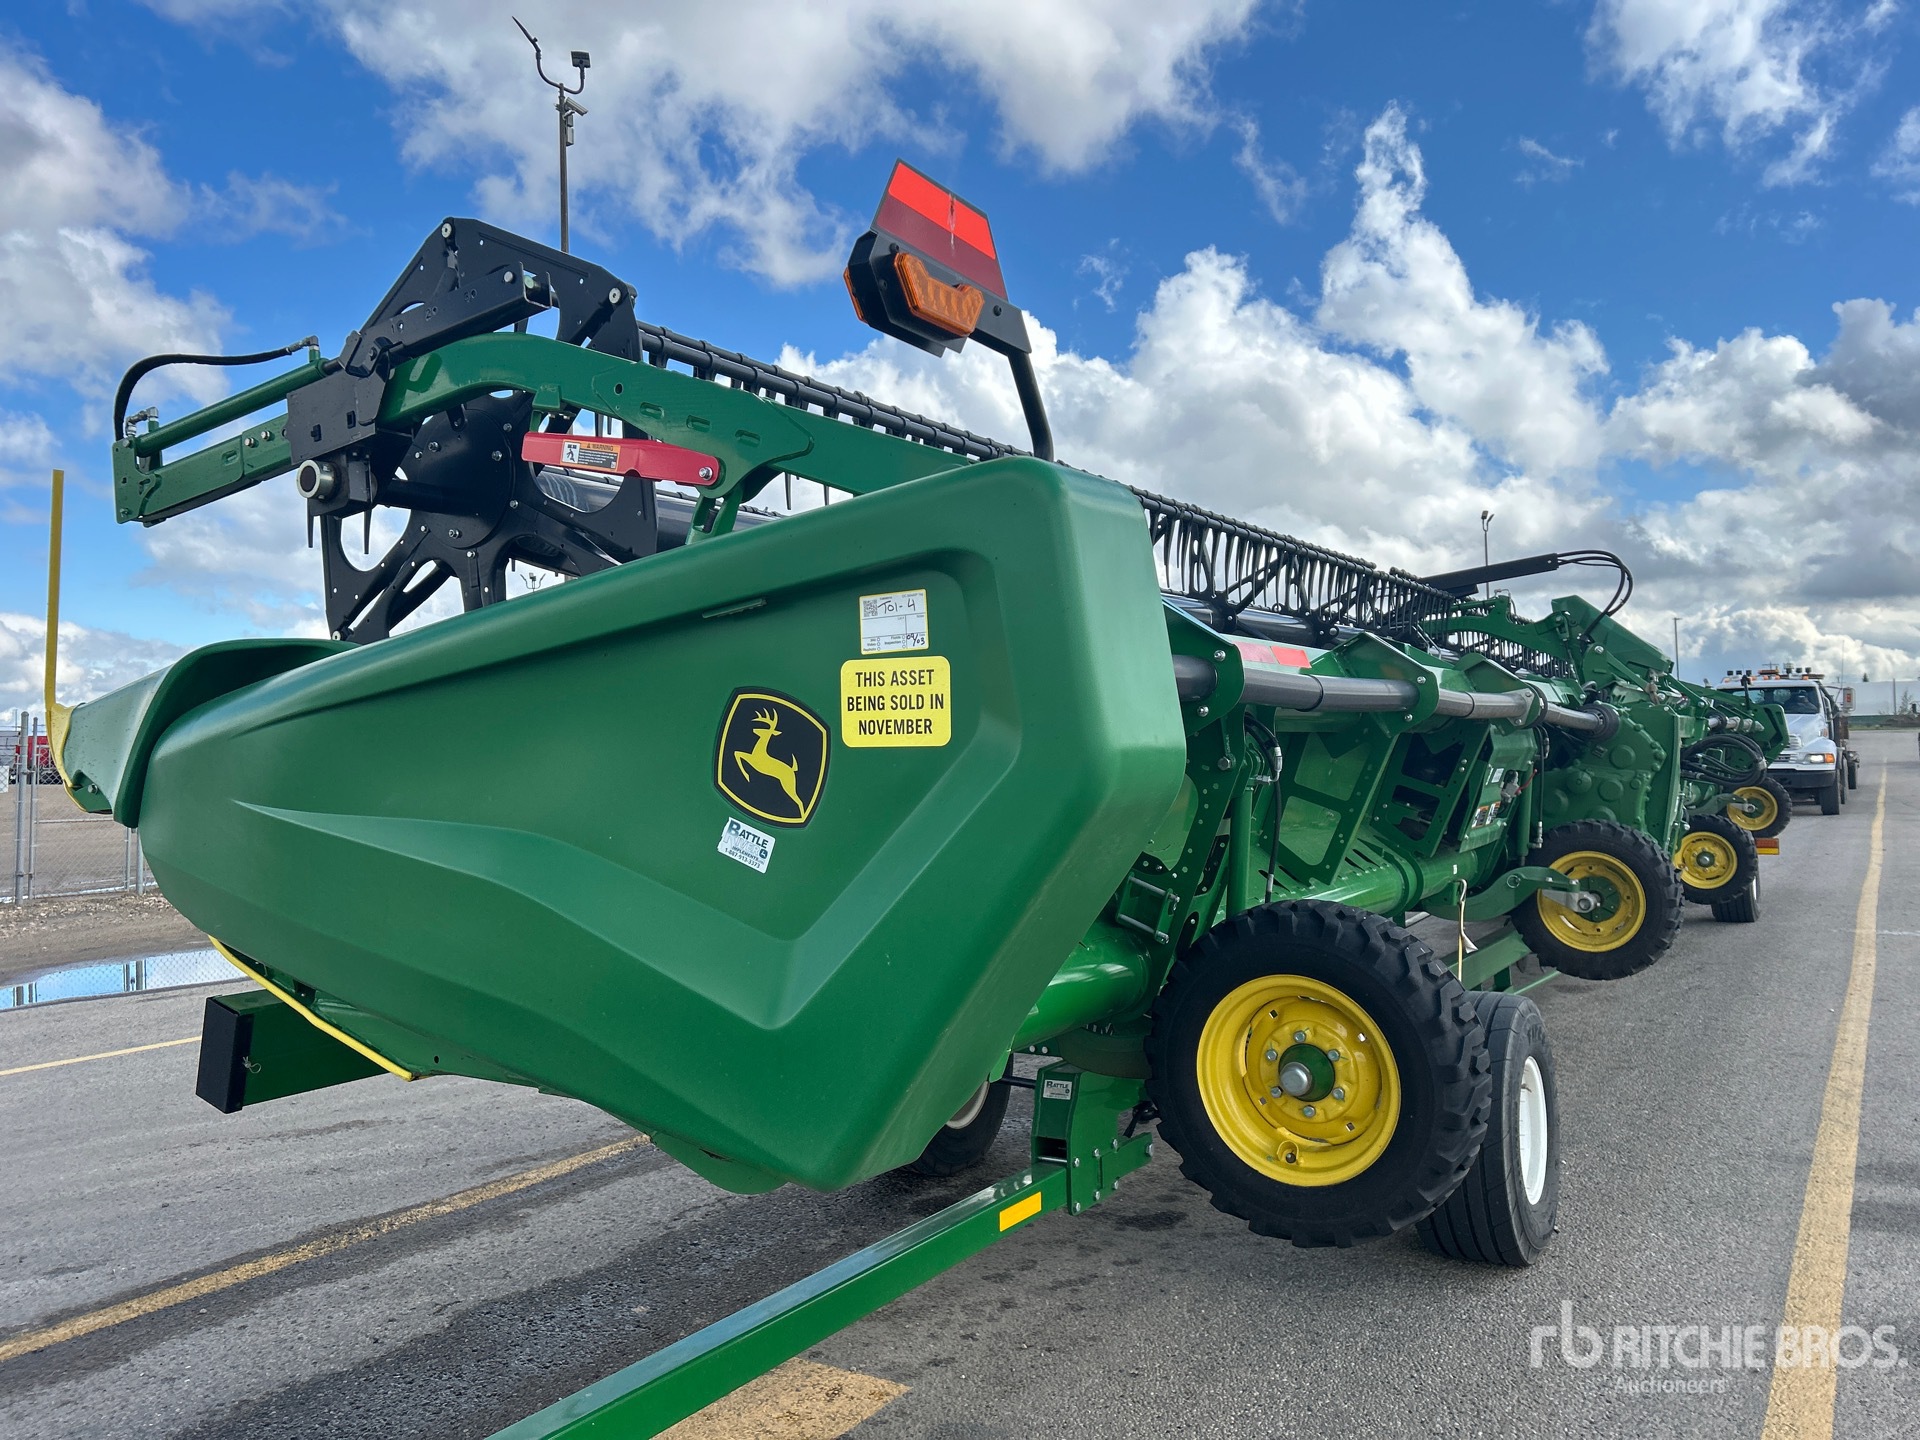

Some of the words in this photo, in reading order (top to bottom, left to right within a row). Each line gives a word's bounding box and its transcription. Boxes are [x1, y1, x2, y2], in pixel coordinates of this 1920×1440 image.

[907, 598, 916, 611] 4
[855, 671, 885, 688] THIS
[890, 669, 934, 686] ASSET
[847, 695, 885, 712] BEING
[890, 694, 924, 710] SOLD
[930, 693, 944, 709] IN
[858, 718, 933, 735] NOVEMBER
[727, 819, 769, 849] BATTLE
